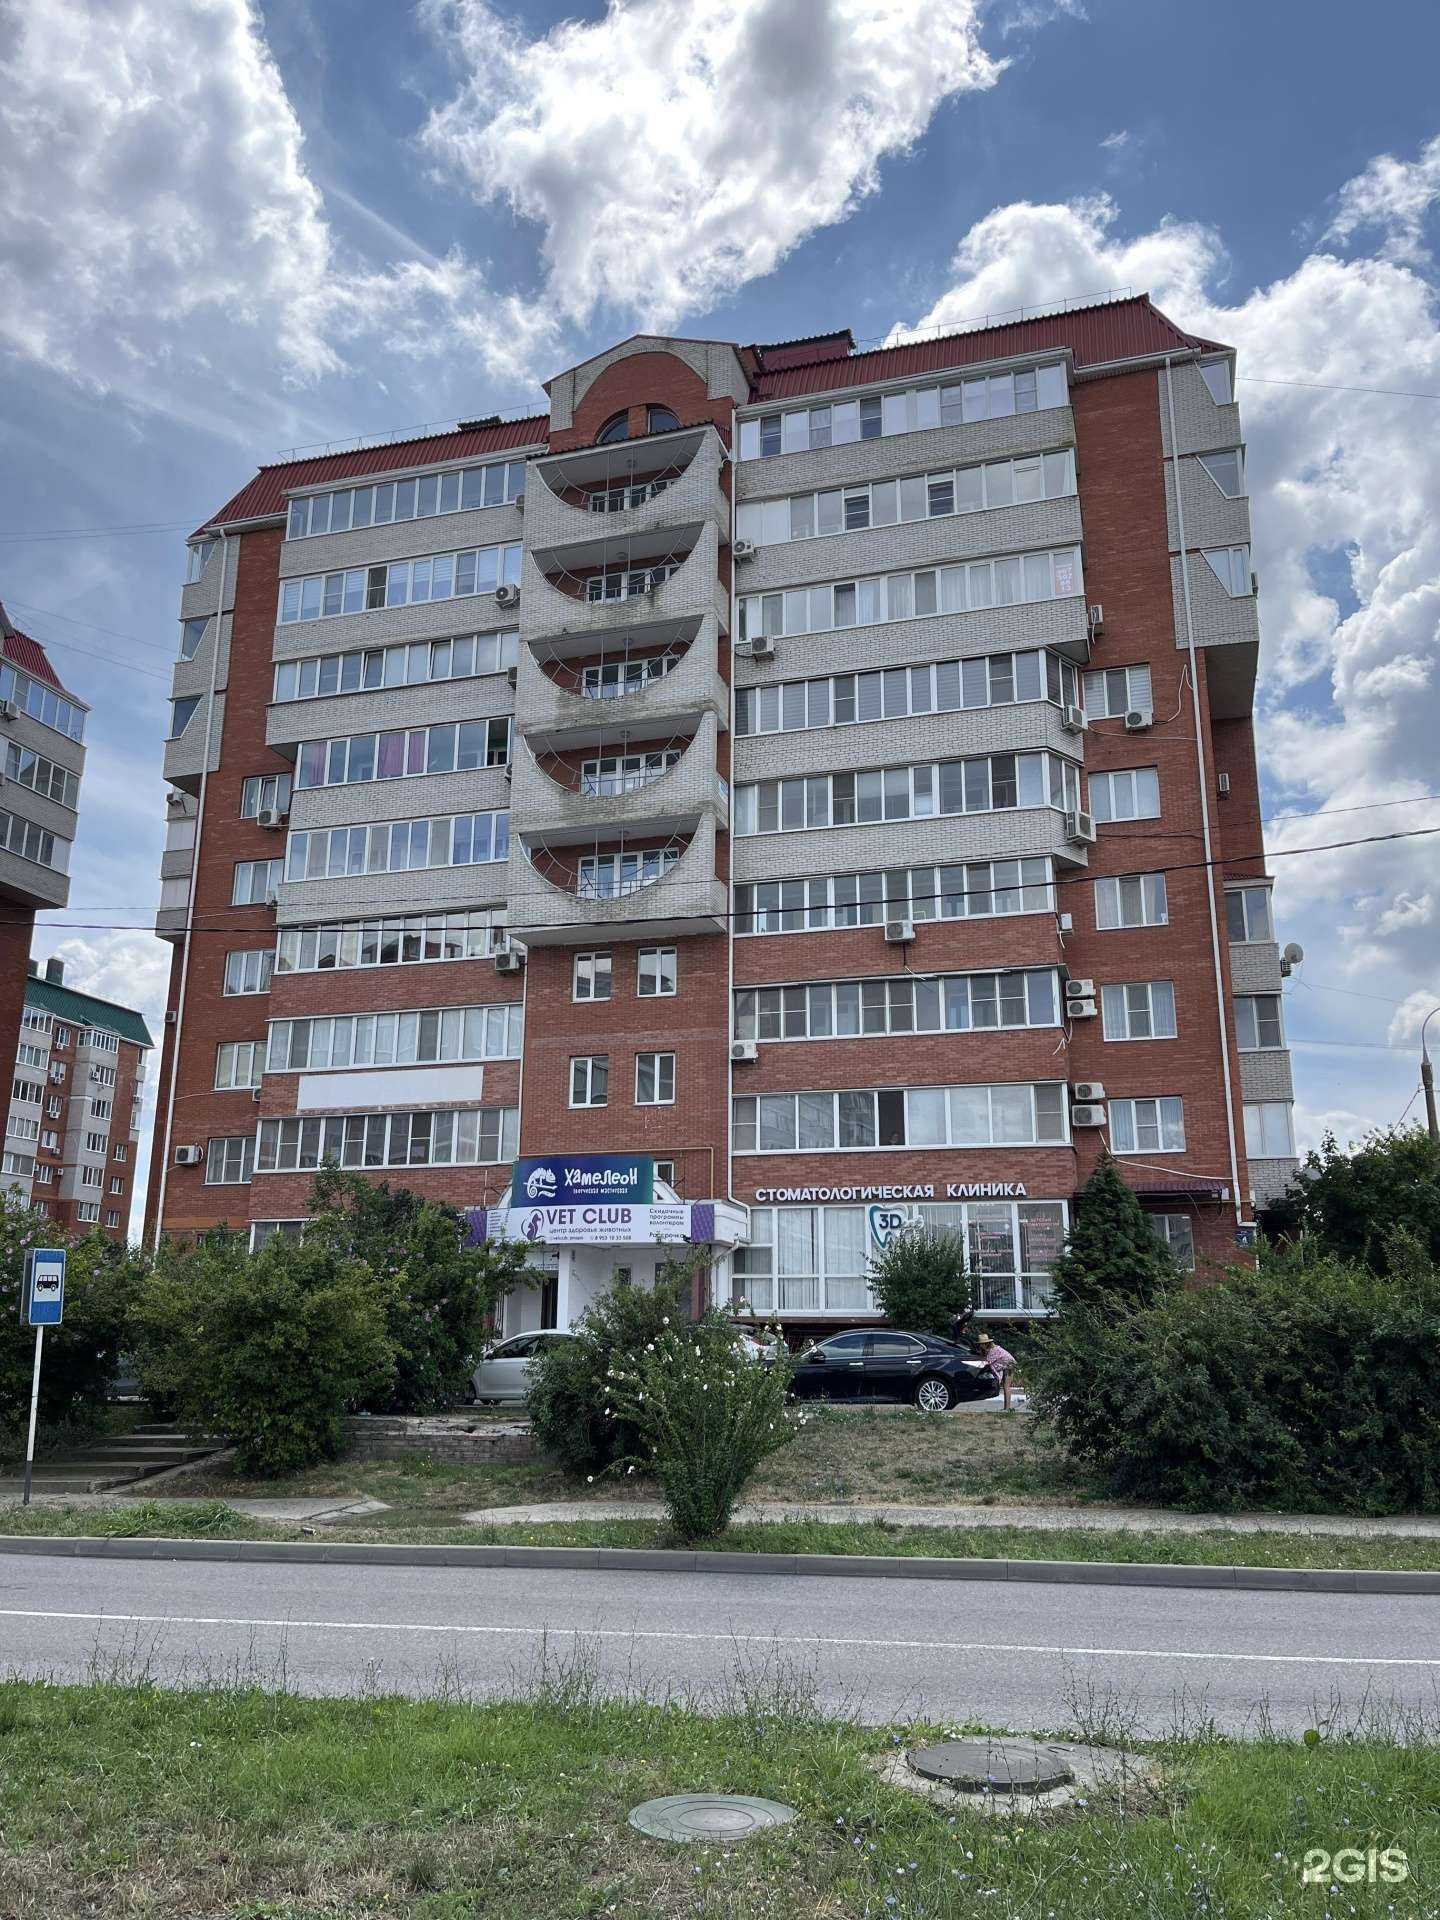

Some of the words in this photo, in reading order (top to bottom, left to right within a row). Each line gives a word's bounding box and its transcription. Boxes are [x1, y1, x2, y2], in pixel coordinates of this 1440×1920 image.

[564, 1167, 638, 1186] Хамелеон
[755, 1185, 934, 1201] СТОМАТОЛОГИЧЕСКАЯ
[946, 1183, 1027, 1197] КЛИНИКА
[546, 1208, 576, 1225] VET
[583, 1207, 632, 1224] CLUB
[879, 1213, 902, 1229] 3D
